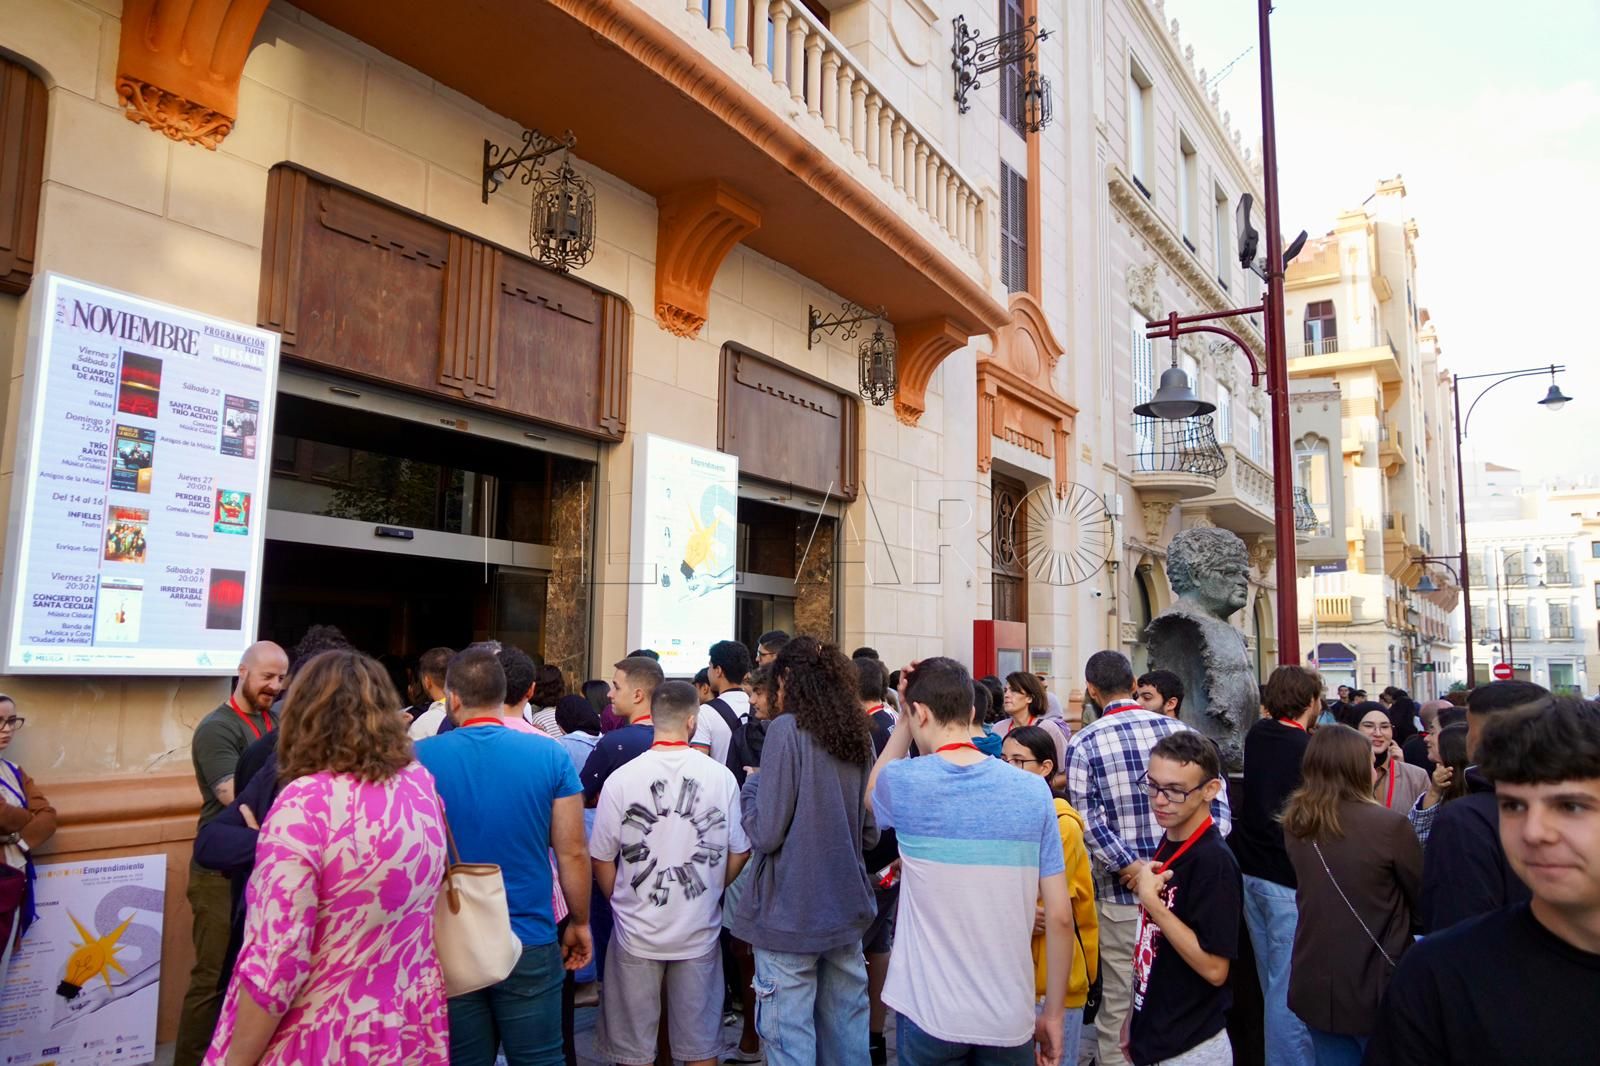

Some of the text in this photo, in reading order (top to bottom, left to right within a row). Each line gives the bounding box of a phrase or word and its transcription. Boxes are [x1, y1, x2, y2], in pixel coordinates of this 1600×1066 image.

[71, 299, 200, 356] NOVIEMBRE
[204, 325, 265, 348] PROGRAMACIÓN
[79, 346, 109, 359] Viernes
[78, 354, 109, 367] Sábado
[82, 366, 115, 378] CUARTO
[77, 372, 114, 385] DE ATRÁS
[182, 382, 221, 396] Sábado 22
[169, 400, 218, 416] SANTA CECILIA
[65, 412, 103, 426] Domingo
[172, 407, 218, 422] TRÍO ACENTO
[81, 423, 103, 432] 12:00
[89, 441, 108, 450] TRÍO
[82, 448, 107, 457] RAVEL
[177, 473, 201, 483] Jueves
[52, 492, 68, 501] Del
[70, 495, 80, 503] 14
[83, 496, 91, 504] al
[175, 492, 202, 501] PERDER
[68, 511, 102, 520] INFIELES
[166, 565, 193, 575] Sábado
[51, 572, 96, 583] Viernes 21
[160, 586, 203, 595] IRREPETIBLE
[33, 593, 82, 603] CONCIERTO
[170, 593, 202, 601] ARRABAL
[33, 601, 94, 610] SANTA CECILIA
[83, 863, 145, 874] Emprendimiento
